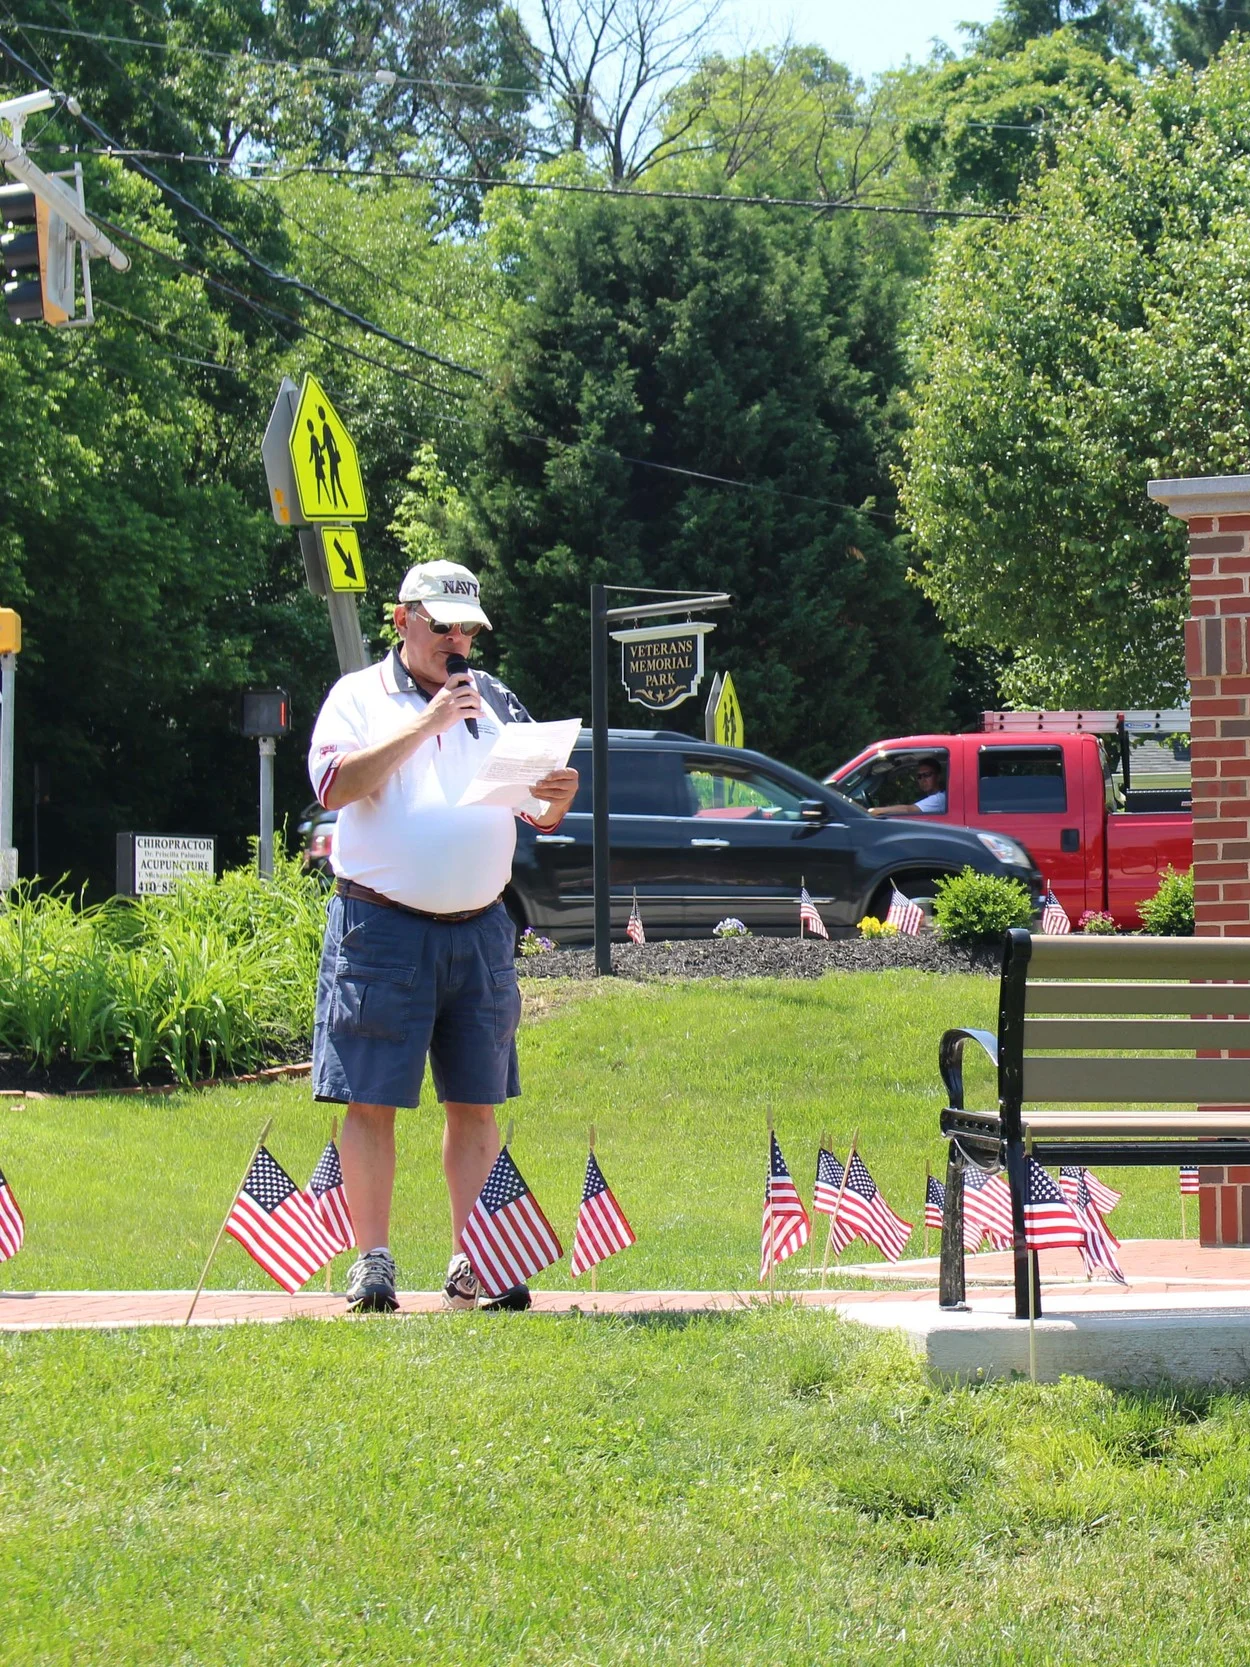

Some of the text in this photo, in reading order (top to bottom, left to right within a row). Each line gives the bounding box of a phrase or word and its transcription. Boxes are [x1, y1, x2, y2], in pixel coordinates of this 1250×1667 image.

[441, 580, 478, 597] NAVY
[630, 640, 693, 658] VETERANS
[630, 656, 692, 673] MEMORIAL
[645, 672, 676, 687] PARK
[137, 839, 212, 851] CHIROPRACTOR
[141, 860, 209, 871] ACUPUNCTURE
